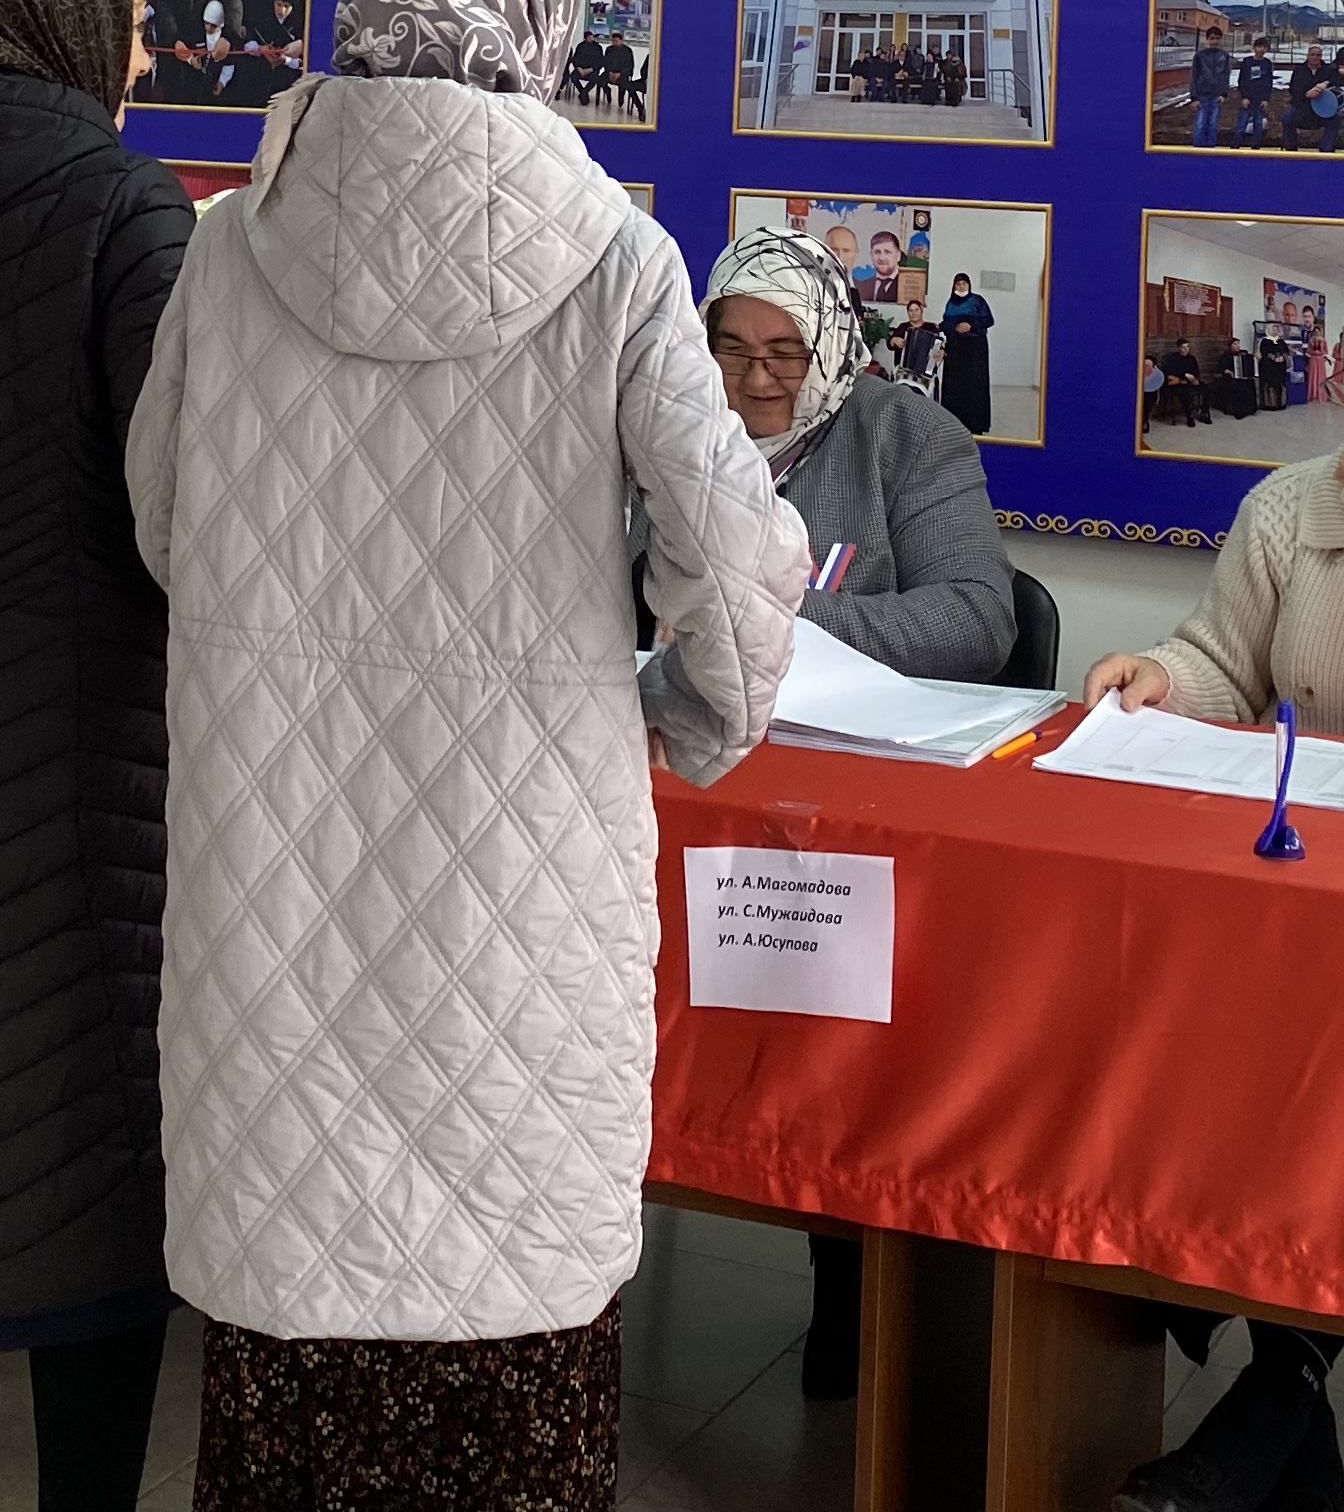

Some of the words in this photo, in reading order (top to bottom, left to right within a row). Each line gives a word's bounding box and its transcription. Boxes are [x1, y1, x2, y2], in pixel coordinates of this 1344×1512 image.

[716, 876, 737, 891] ул.
[742, 875, 851, 896] А.Магомадова
[717, 904, 738, 919] ул.
[743, 904, 843, 925] С.Мужаидова
[717, 933, 738, 948] ул.
[742, 932, 818, 952] А.Юсупова
